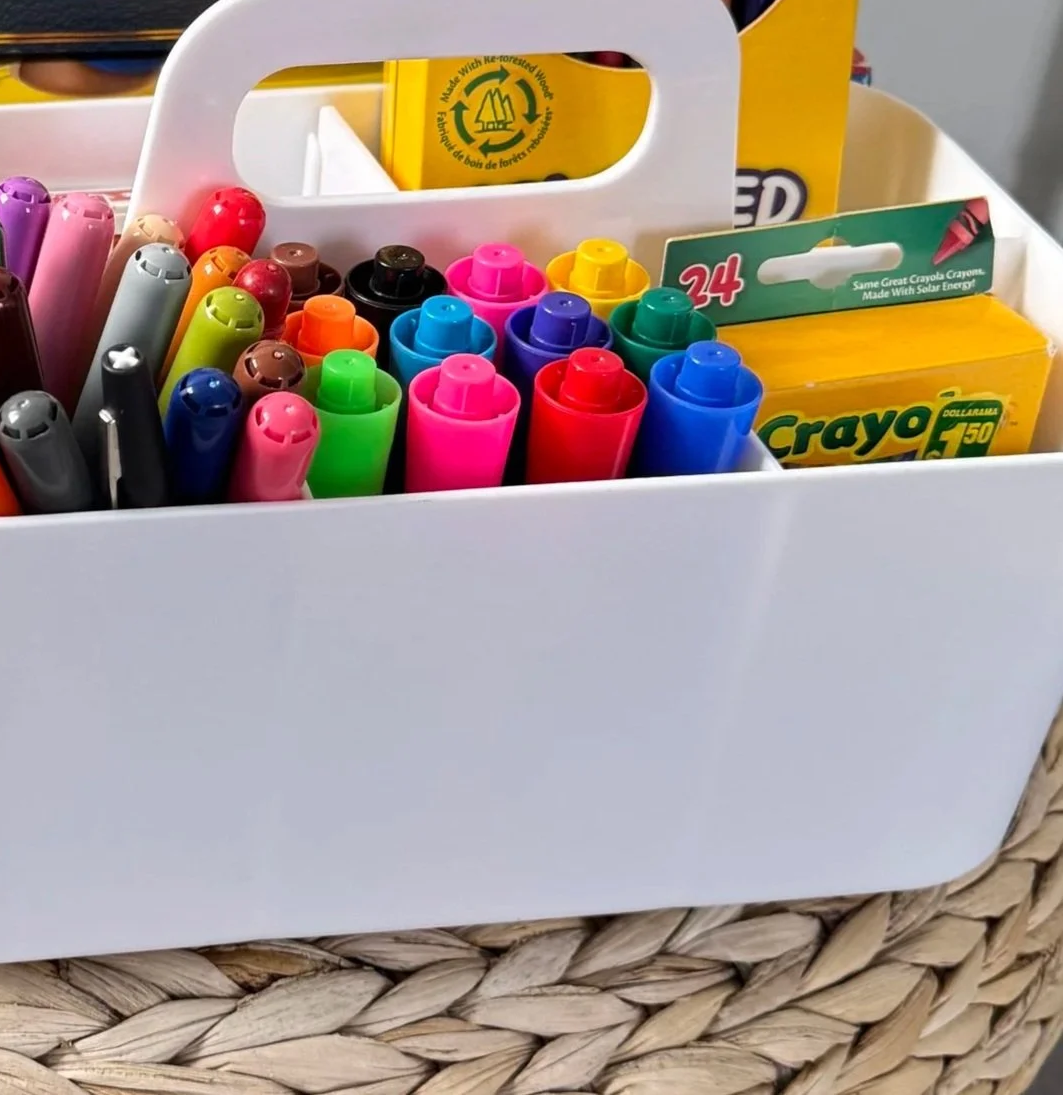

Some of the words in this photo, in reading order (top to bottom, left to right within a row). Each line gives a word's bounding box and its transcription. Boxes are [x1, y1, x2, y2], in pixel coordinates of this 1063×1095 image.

[440, 76, 461, 103] Made
[458, 58, 483, 77] With
[437, 111, 454, 152] Fabriqué
[452, 149, 464, 162] de
[463, 155, 483, 169] bois
[485, 160, 498, 170] de
[499, 151, 527, 169] forêts
[678, 252, 745, 309] 24
[852, 280, 880, 291] Same
[881, 277, 908, 287] Great
[909, 272, 945, 285] Crayola
[862, 290, 890, 301] Made
[891, 287, 915, 297] With
[916, 283, 941, 294] Solar
[941, 407, 1000, 418] DOLLARAMA
